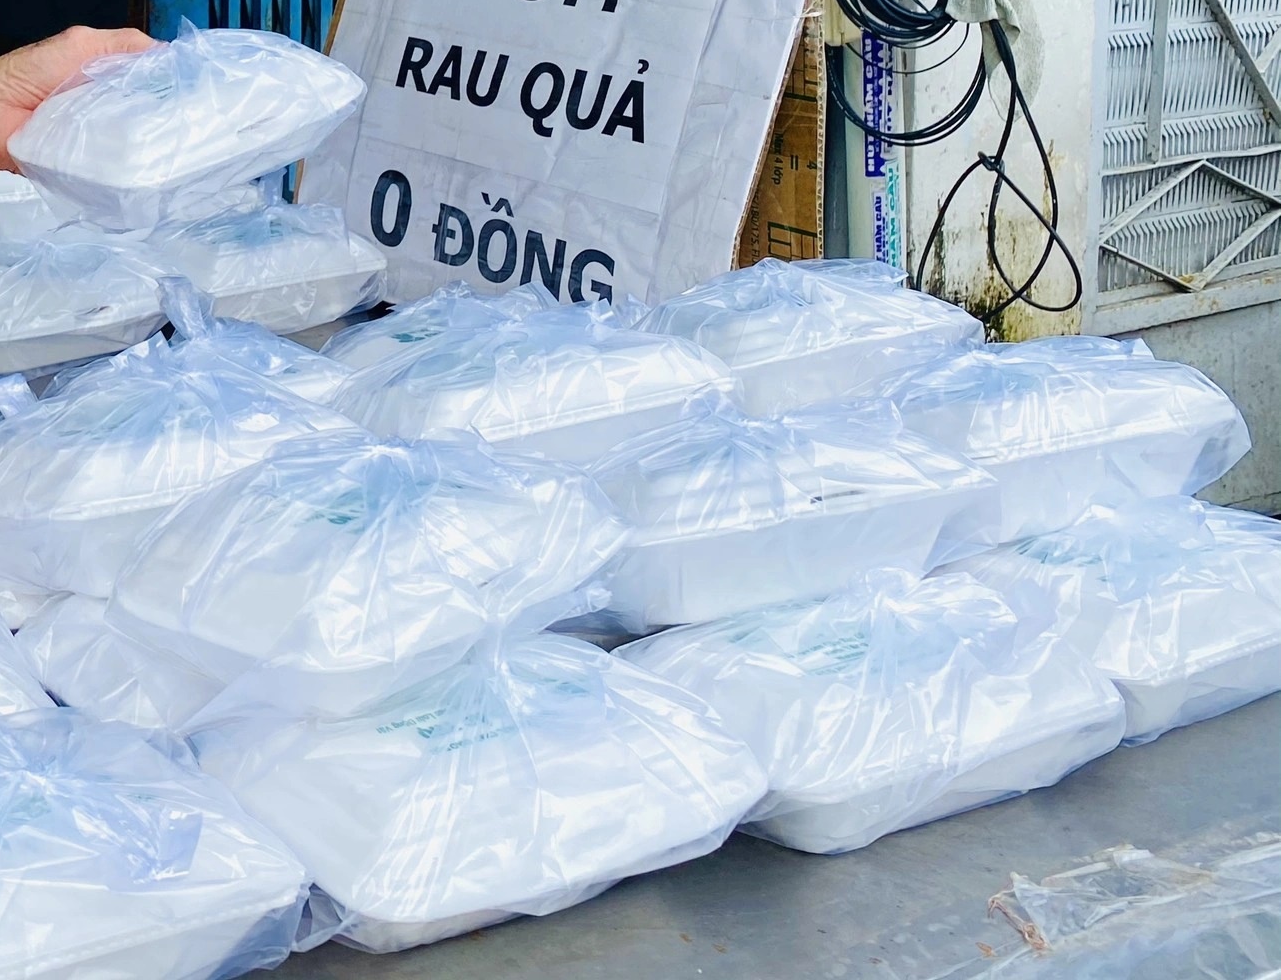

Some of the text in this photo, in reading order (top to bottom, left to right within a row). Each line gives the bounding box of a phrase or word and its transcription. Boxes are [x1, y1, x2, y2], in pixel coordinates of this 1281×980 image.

[395, 36, 650, 143] RAU QUẢ
[431, 191, 617, 306] ĐỒNG
